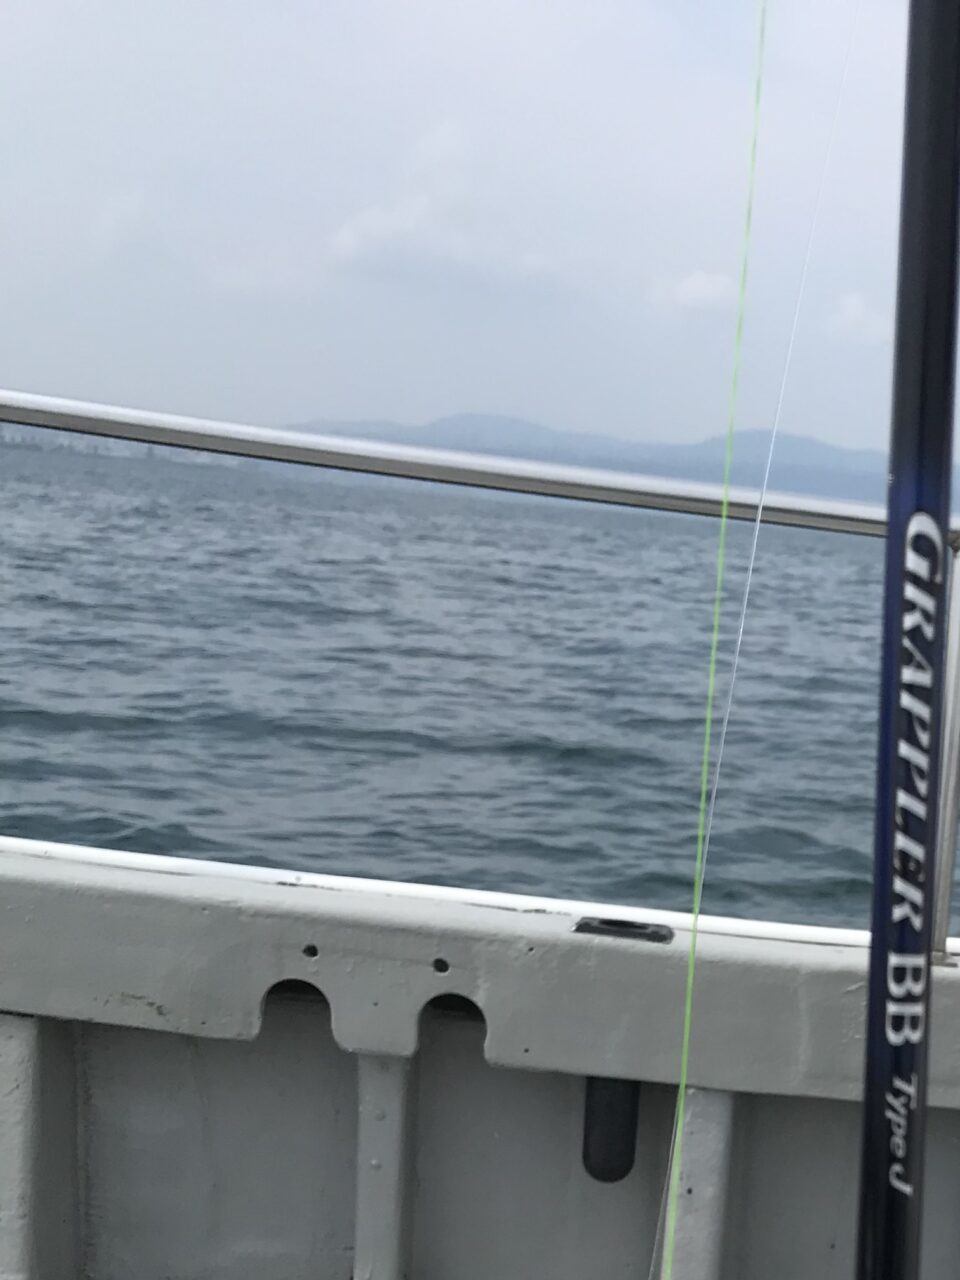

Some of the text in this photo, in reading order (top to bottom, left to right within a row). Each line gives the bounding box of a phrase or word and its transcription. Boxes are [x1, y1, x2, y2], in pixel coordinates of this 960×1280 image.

[885, 511, 943, 1196] GRAPPLER BB Type J
